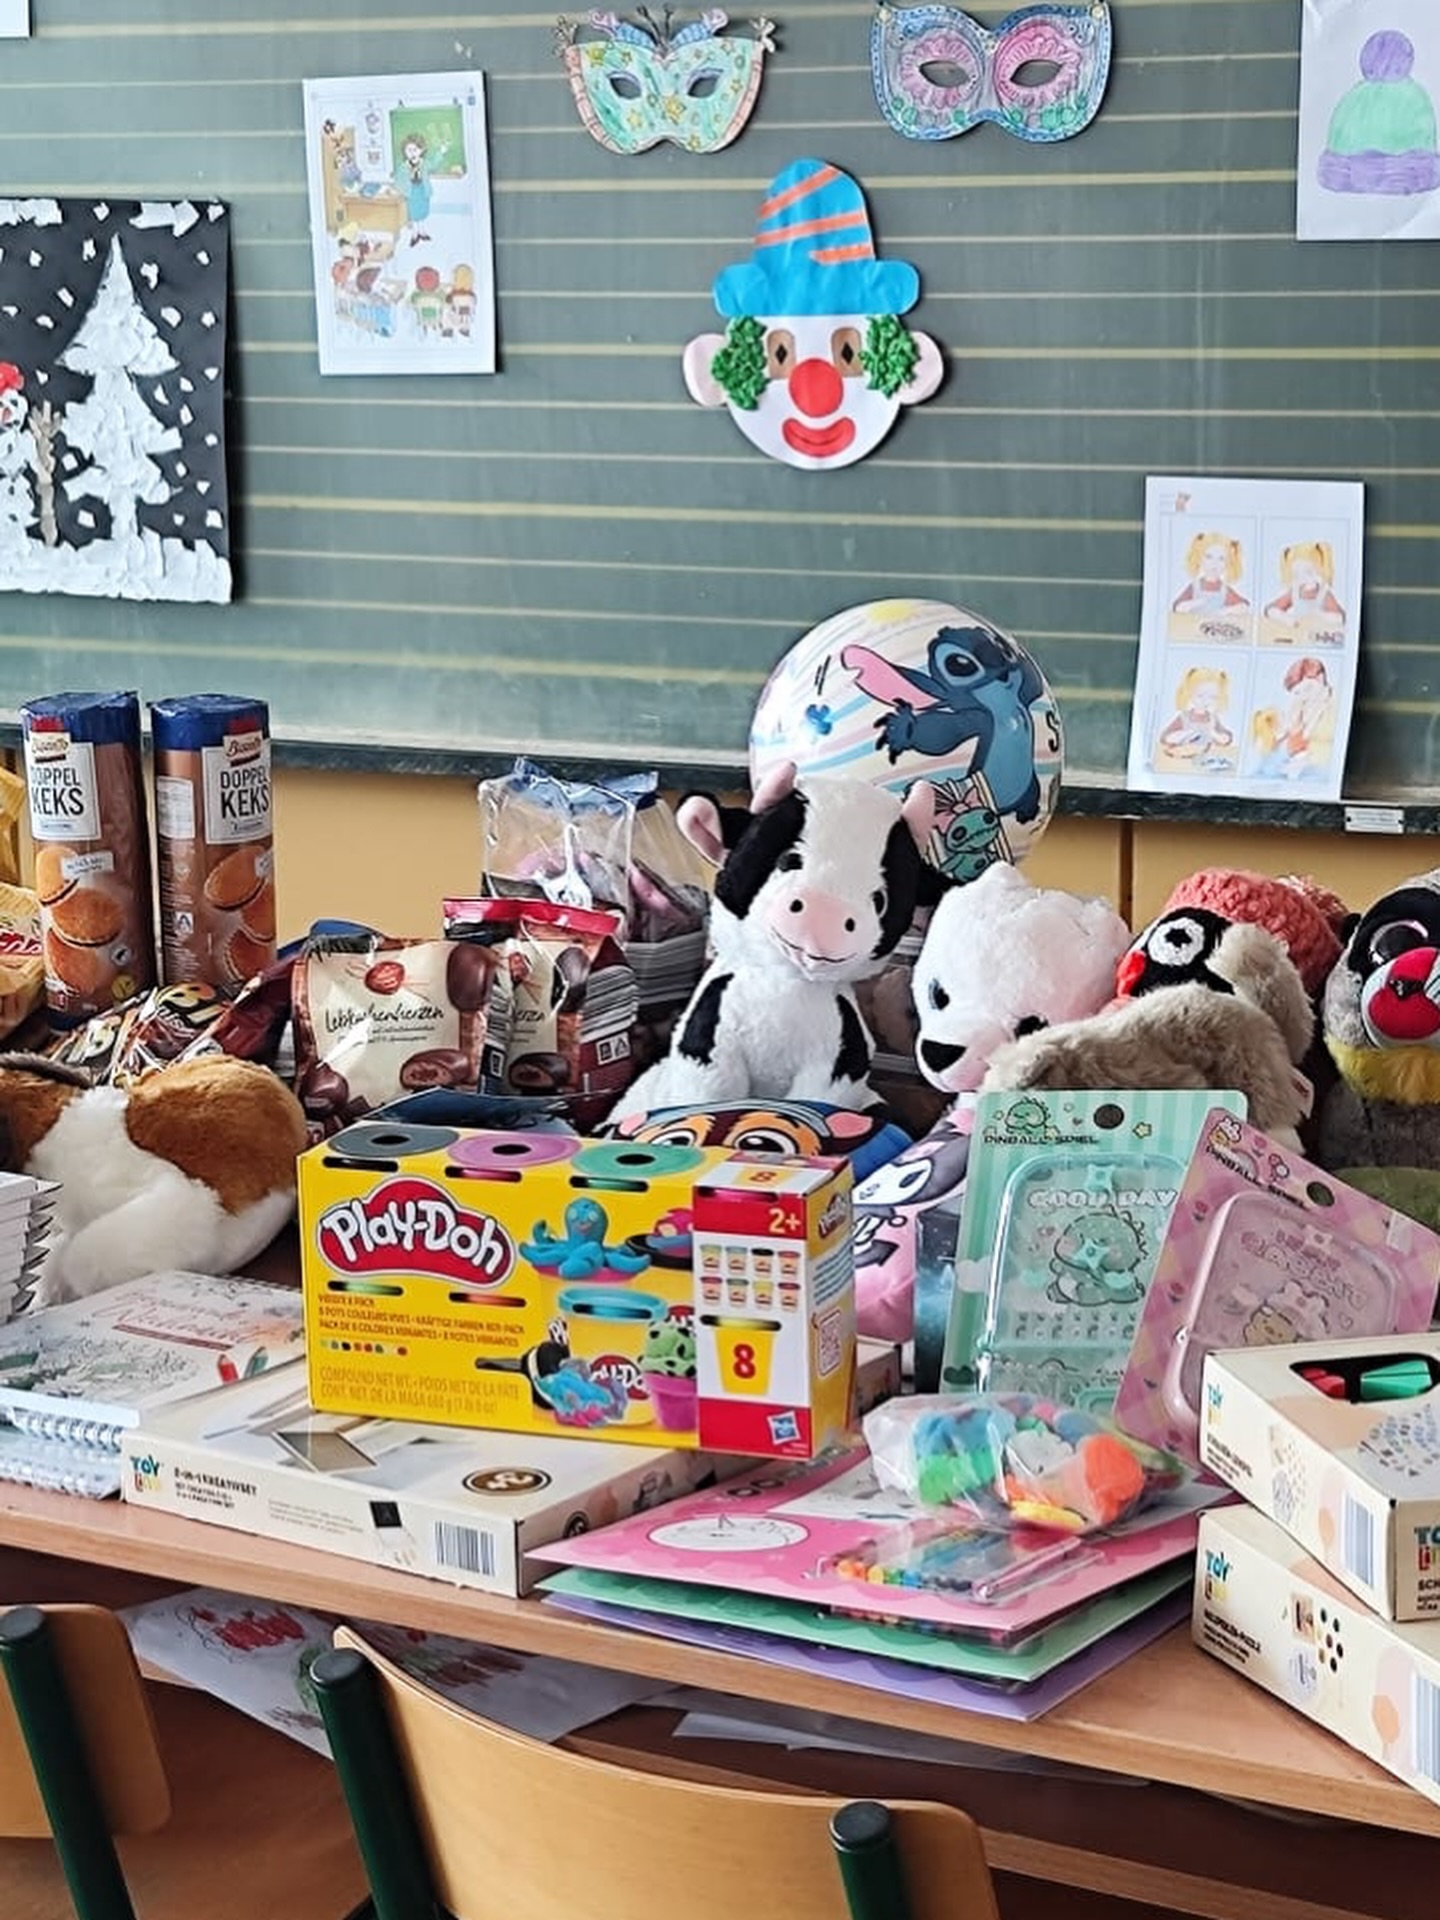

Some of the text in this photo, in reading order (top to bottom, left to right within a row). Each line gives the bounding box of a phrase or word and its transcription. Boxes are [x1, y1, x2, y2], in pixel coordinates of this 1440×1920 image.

[32, 788, 84, 816] KEKS
[221, 784, 269, 819] KEKS
[984, 1135, 1047, 1146] PINBALL
[1118, 1189, 1178, 1208] DAY
[769, 1208, 801, 1234] 2+
[321, 1198, 505, 1275] Play-Doh
[732, 1344, 756, 1379] 8
[130, 1455, 160, 1477] TOY
[1206, 1551, 1231, 1583] TOY
